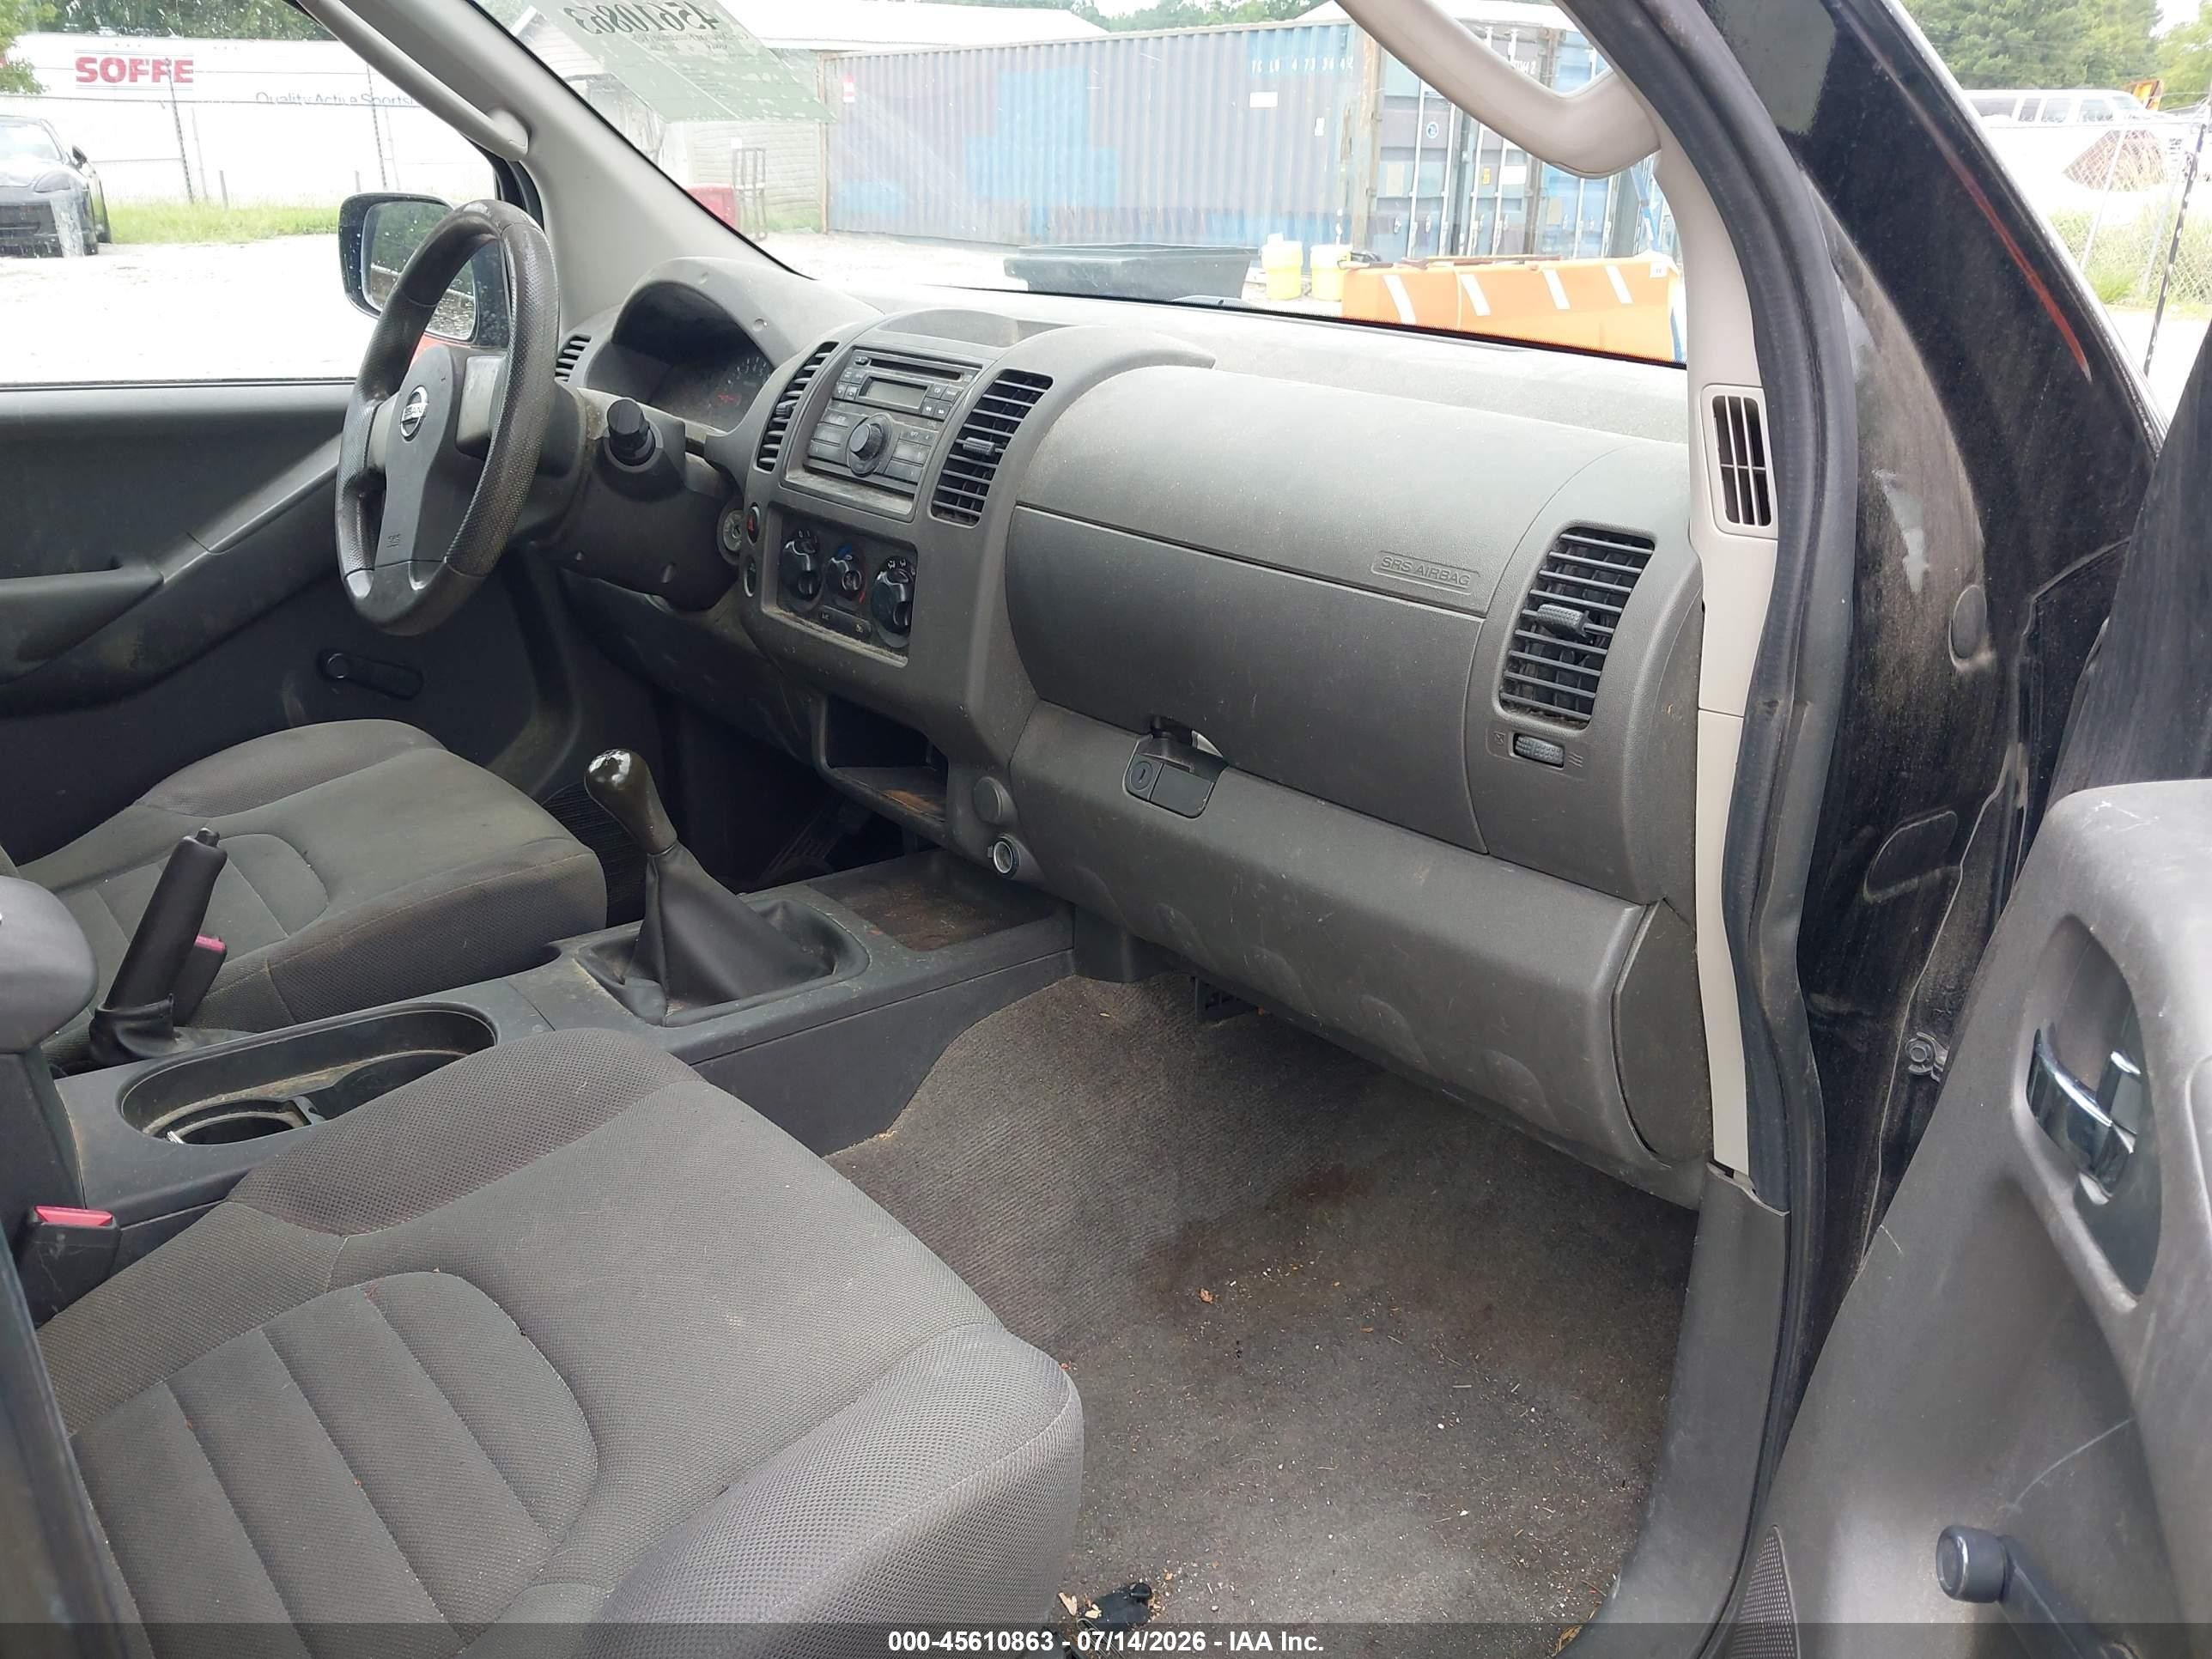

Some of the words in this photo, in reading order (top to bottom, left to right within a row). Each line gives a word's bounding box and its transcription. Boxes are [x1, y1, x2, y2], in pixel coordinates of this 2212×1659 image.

[75, 57, 194, 83] SOFFE
[1381, 556, 1413, 573] SRS
[1415, 564, 1471, 586] AIRBAG
